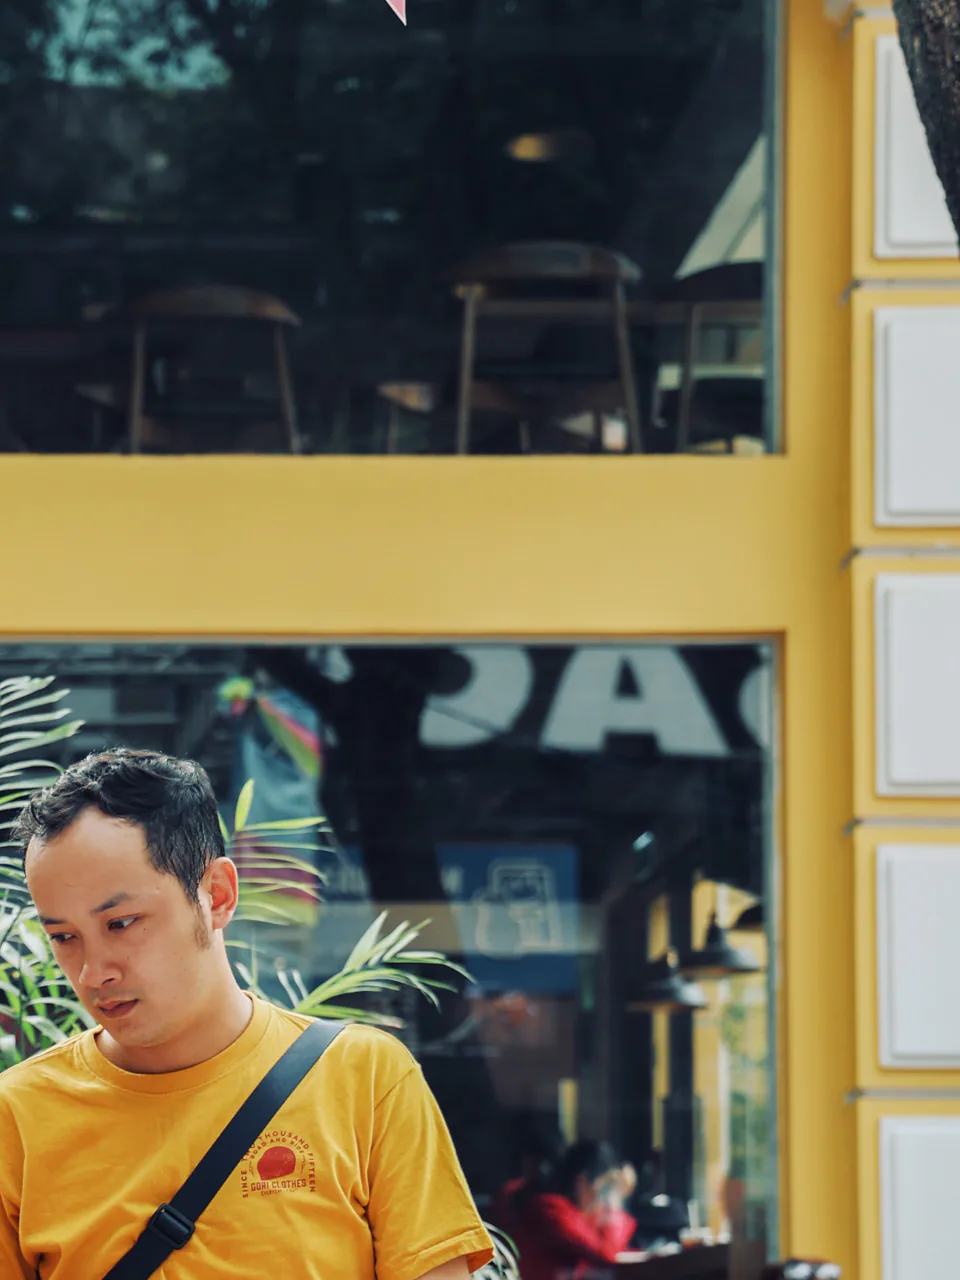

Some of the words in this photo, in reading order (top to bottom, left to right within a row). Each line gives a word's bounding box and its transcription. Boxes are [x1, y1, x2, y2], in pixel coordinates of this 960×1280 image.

[257, 1130, 309, 1150] THOUSAND
[308, 1153, 316, 1192] FIFTEEN
[271, 1178, 307, 1189] CLOTHES
